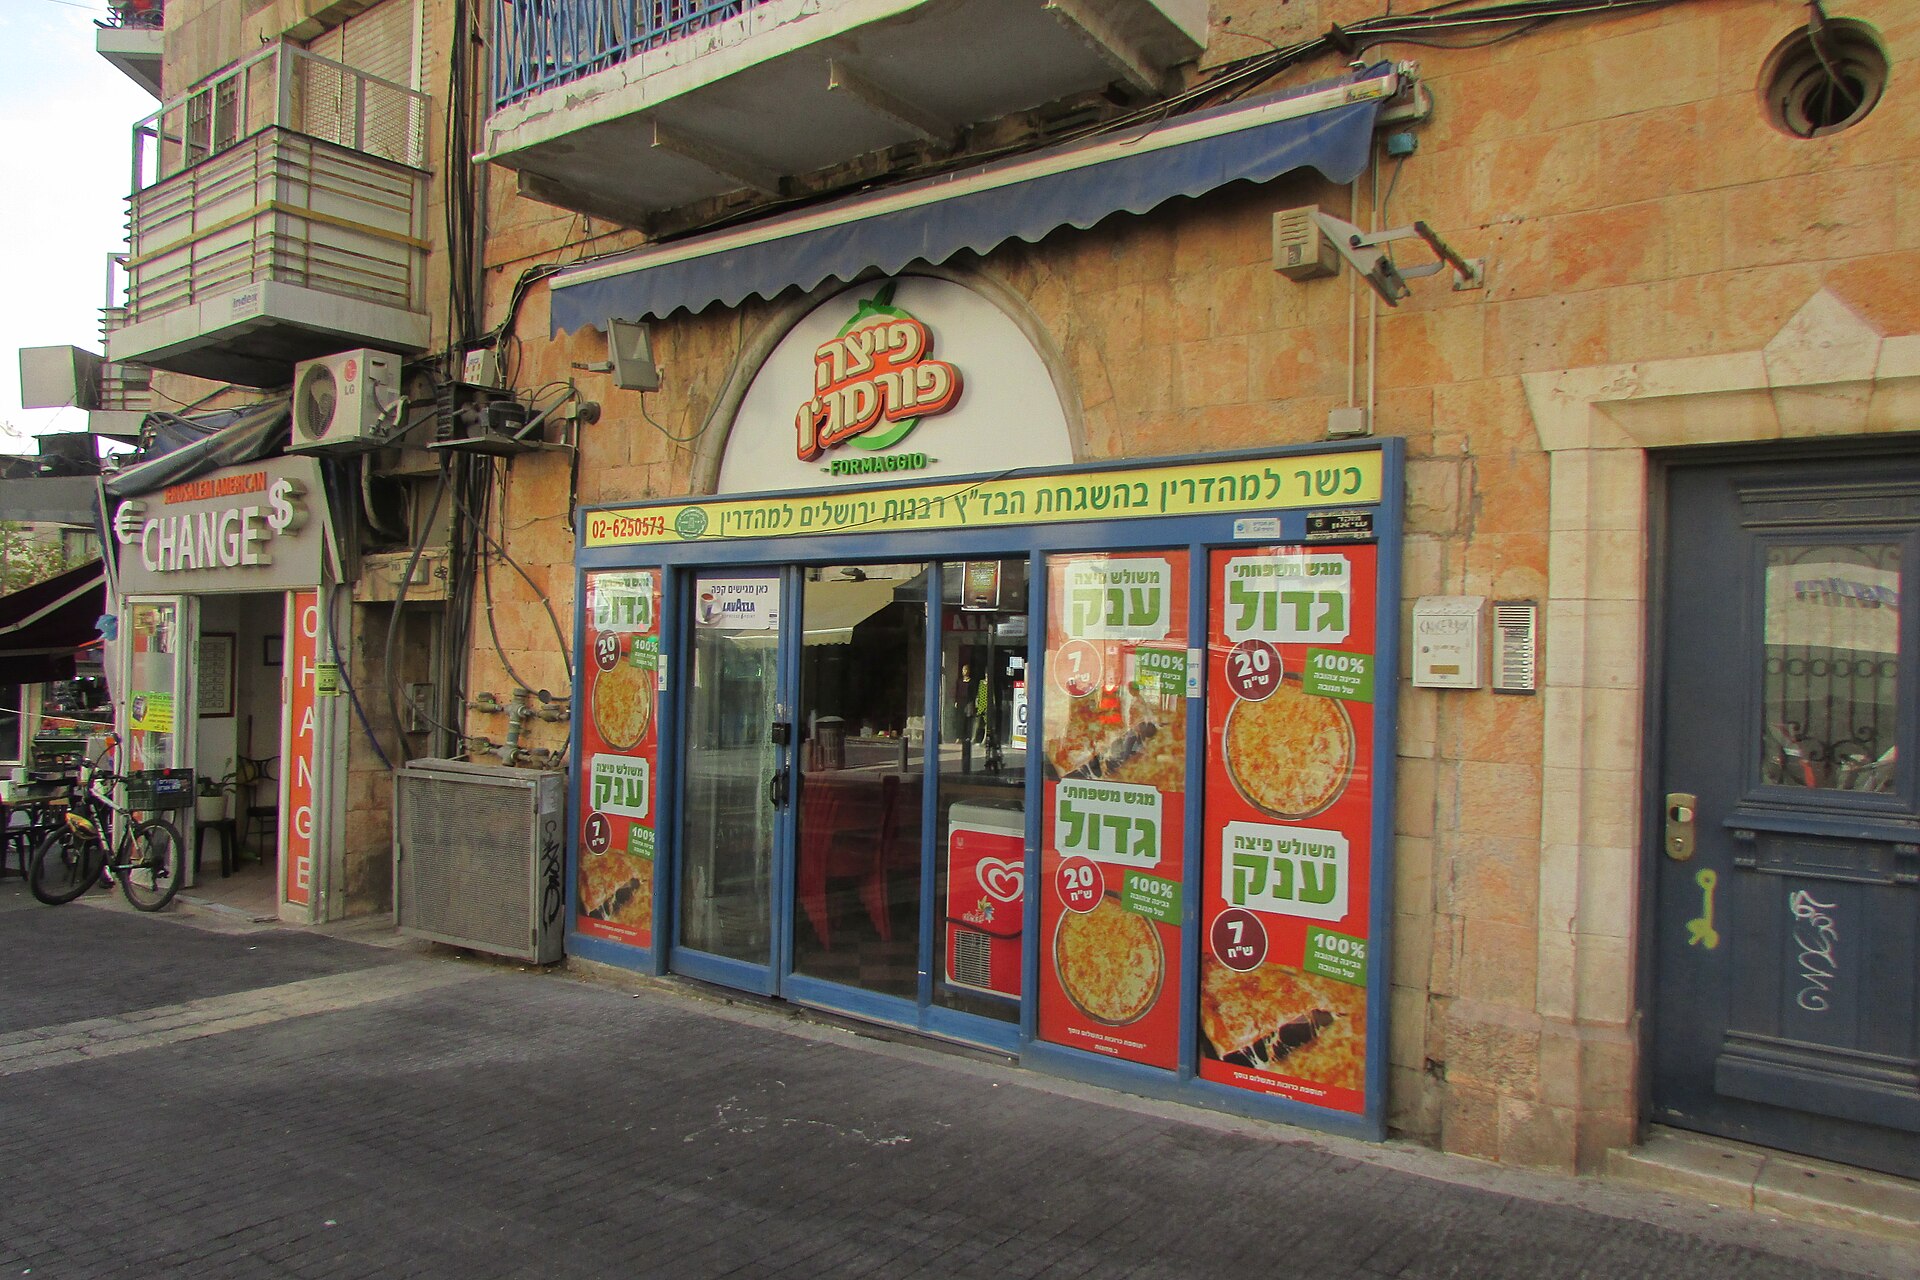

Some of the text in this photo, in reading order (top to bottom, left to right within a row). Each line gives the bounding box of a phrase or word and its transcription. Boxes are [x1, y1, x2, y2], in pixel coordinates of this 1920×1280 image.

[817, 323, 920, 391] פיצה
[344, 383, 355, 396] LG
[831, 452, 926, 476] FORMAGGIO
[214, 471, 267, 499] AMERICAN
[1160, 466, 1282, 513] למהדרין
[1294, 466, 1363, 497] כשר
[800, 493, 876, 528] ירושלים
[882, 496, 945, 525] רבנות
[1034, 481, 1149, 516] בהשגחת
[591, 516, 665, 539] 02-6250573
[720, 503, 793, 537] למהדרין
[142, 506, 260, 572] CHANGE
[1111, 569, 1160, 584] משולש
[1233, 561, 1342, 578] מגש משפחתי
[711, 585, 768, 596] כאן מגישים קפה
[722, 598, 755, 612] LAVAZZA
[1072, 587, 1161, 637] ענק
[1229, 580, 1345, 633] גדול
[598, 636, 616, 655] 20
[635, 639, 658, 653] 100%
[1067, 651, 1082, 673] 7
[1141, 653, 1185, 671] 100%
[1234, 649, 1270, 678] 20
[1313, 653, 1365, 674] 100%
[1243, 674, 1269, 690] ש"ח
[597, 762, 643, 777] משולש פיצה
[595, 775, 644, 810] ענק
[1063, 785, 1155, 806] מגש משפחתי
[592, 820, 601, 837] 7
[632, 827, 655, 843] 100%
[1060, 800, 1156, 857] גדול
[1234, 835, 1336, 859] משולש פיצה
[1063, 865, 1094, 889] 20
[1130, 876, 1173, 899] 100%
[1232, 853, 1337, 905] ענק
[1070, 889, 1092, 901] ש"ח
[1227, 920, 1244, 944] 7
[1227, 945, 1253, 958] ש"ח
[1314, 933, 1365, 959] 100%
